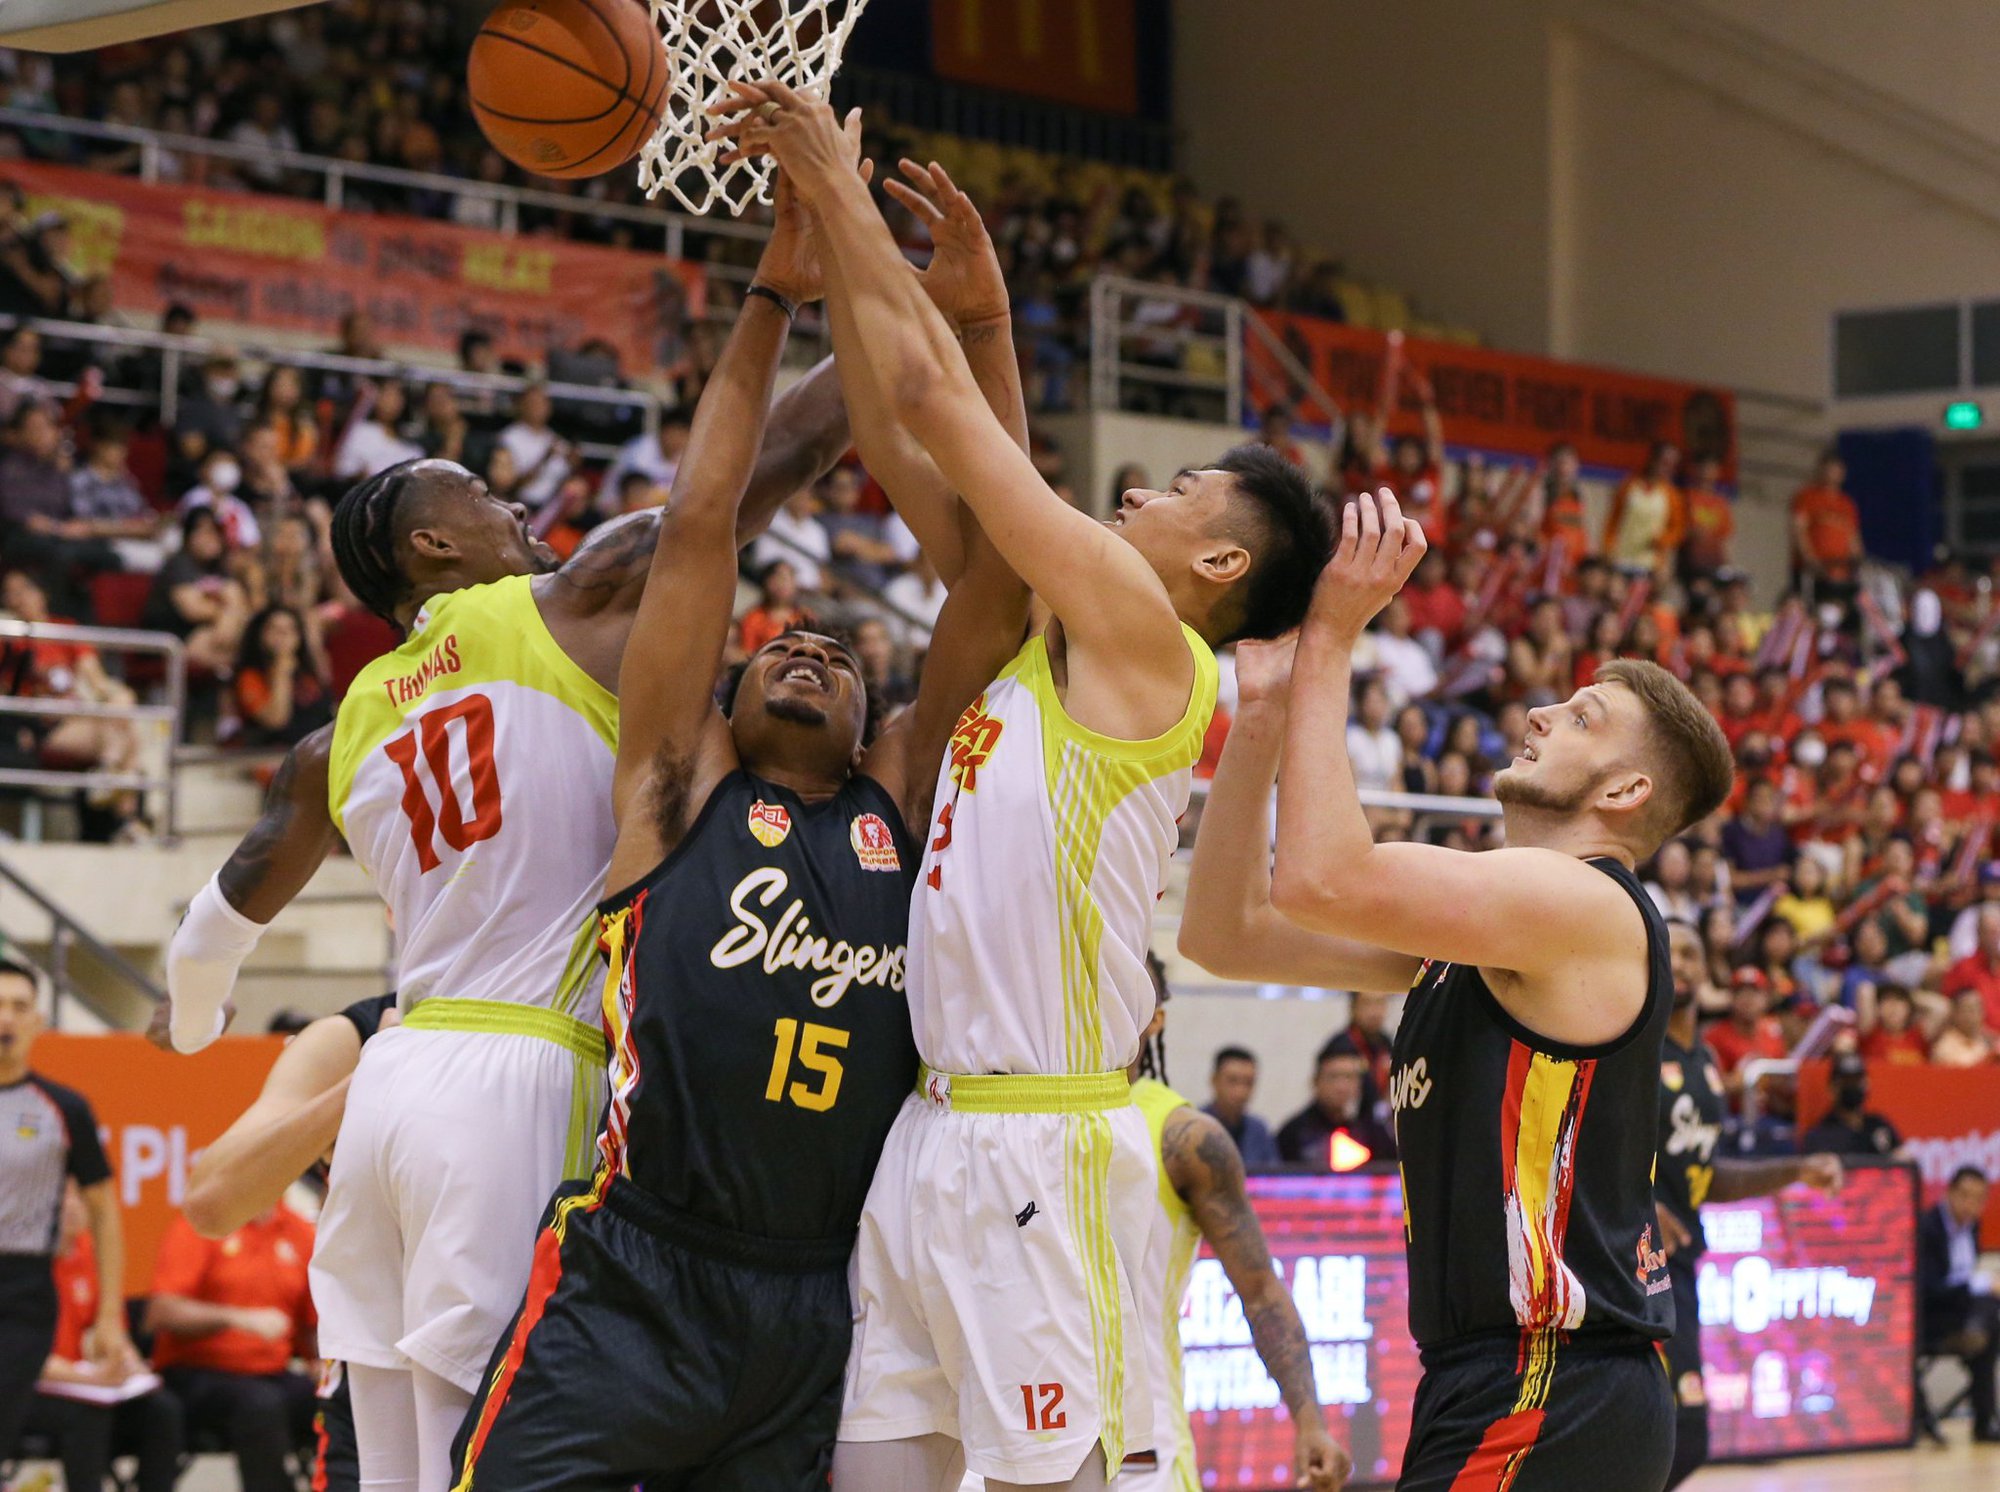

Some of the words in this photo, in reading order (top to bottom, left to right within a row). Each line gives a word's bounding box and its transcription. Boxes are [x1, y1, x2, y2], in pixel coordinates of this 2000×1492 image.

[384, 693, 502, 875] 10
[752, 802, 788, 825] ABL
[710, 867, 906, 1008] Slingers
[765, 1017, 850, 1112] 15
[1020, 1382, 1067, 1431] 12
